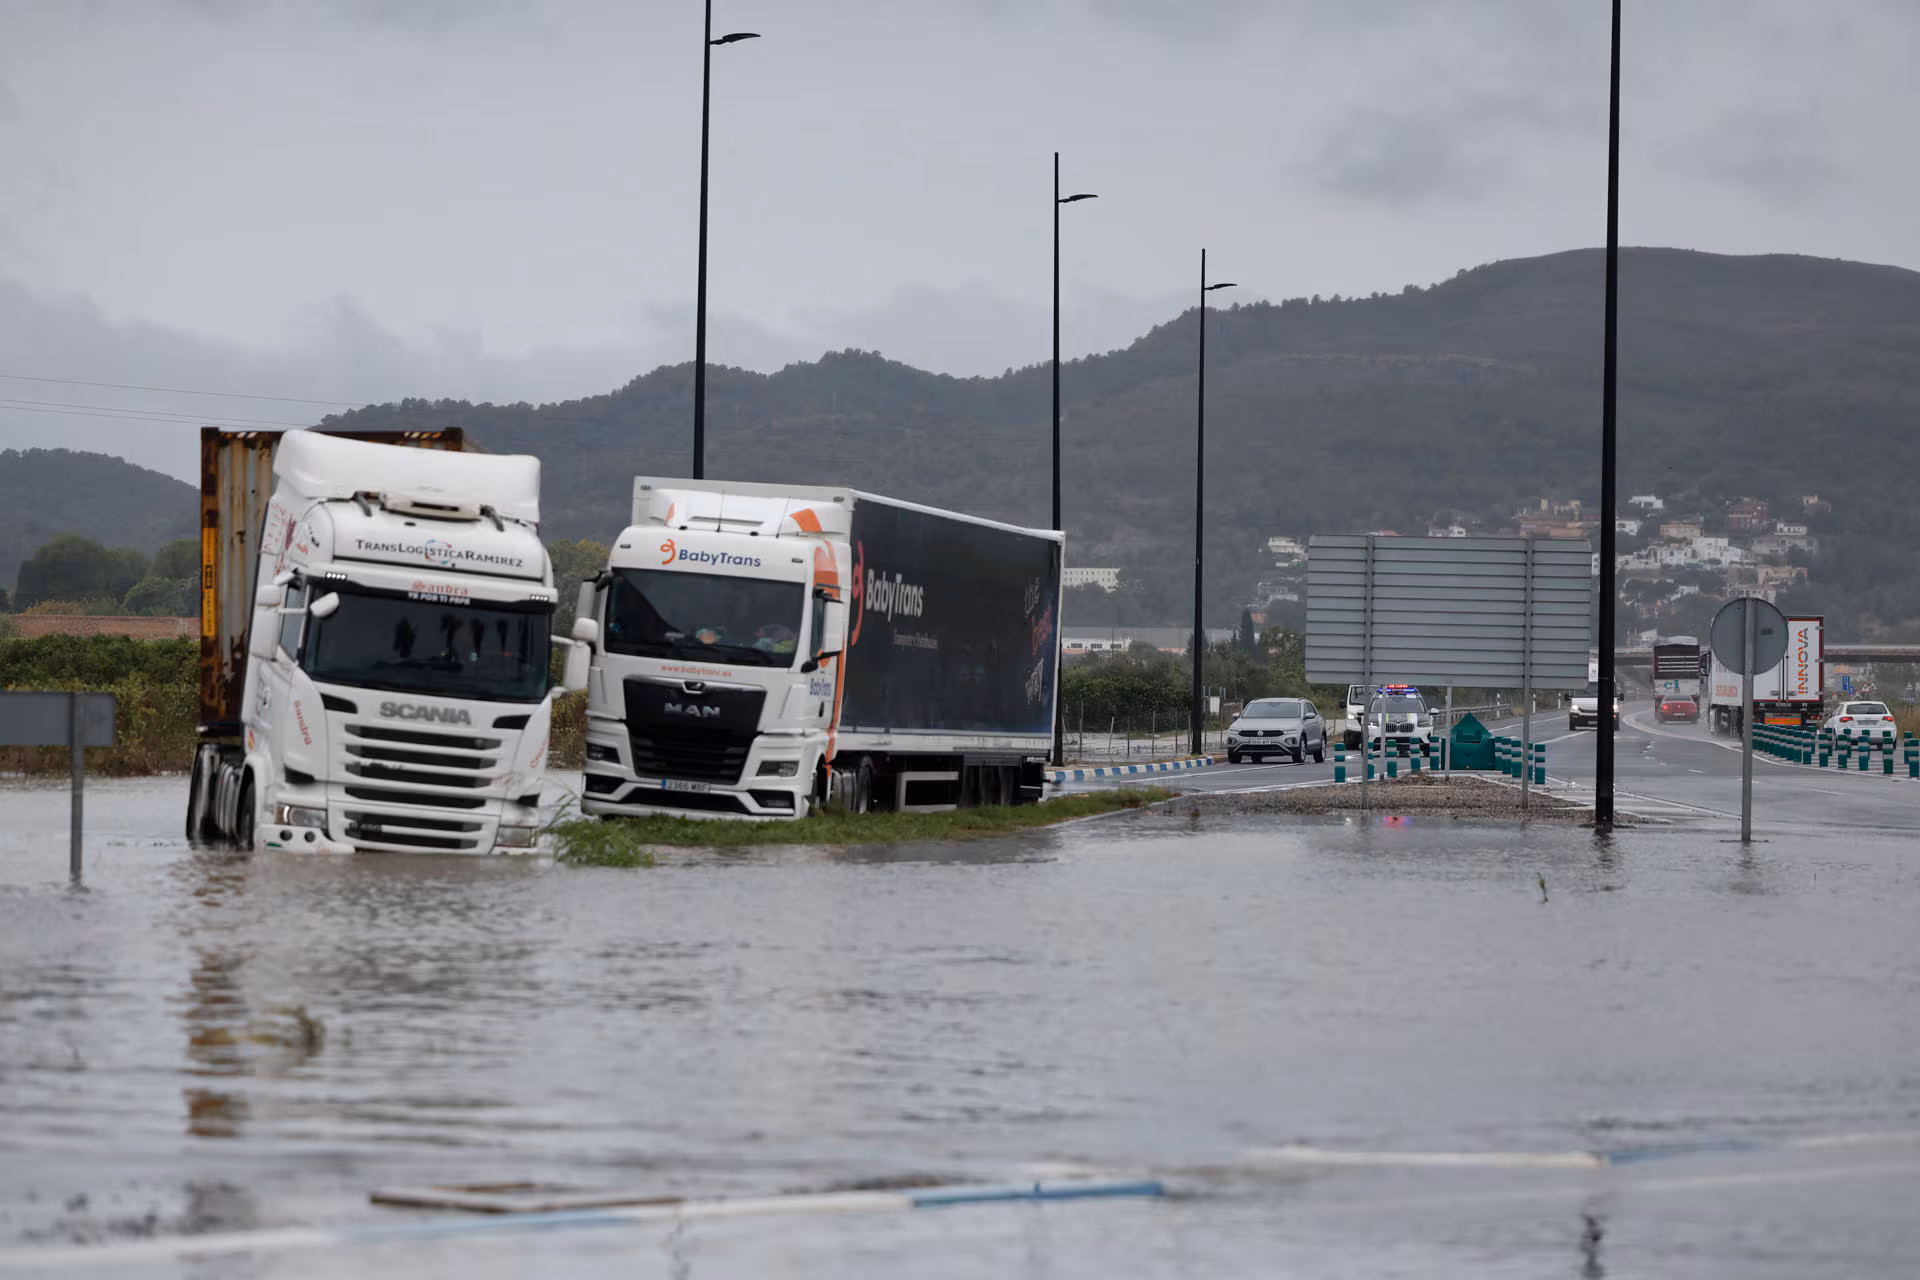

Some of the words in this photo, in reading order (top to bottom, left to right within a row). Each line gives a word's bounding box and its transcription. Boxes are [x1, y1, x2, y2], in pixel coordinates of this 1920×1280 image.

[679, 548, 762, 567] BabyTrans
[865, 568, 924, 623] BabyTrans
[1797, 627, 1809, 695] INNOVA
[379, 701, 472, 726] SCANIA
[664, 702, 721, 718] MAN
